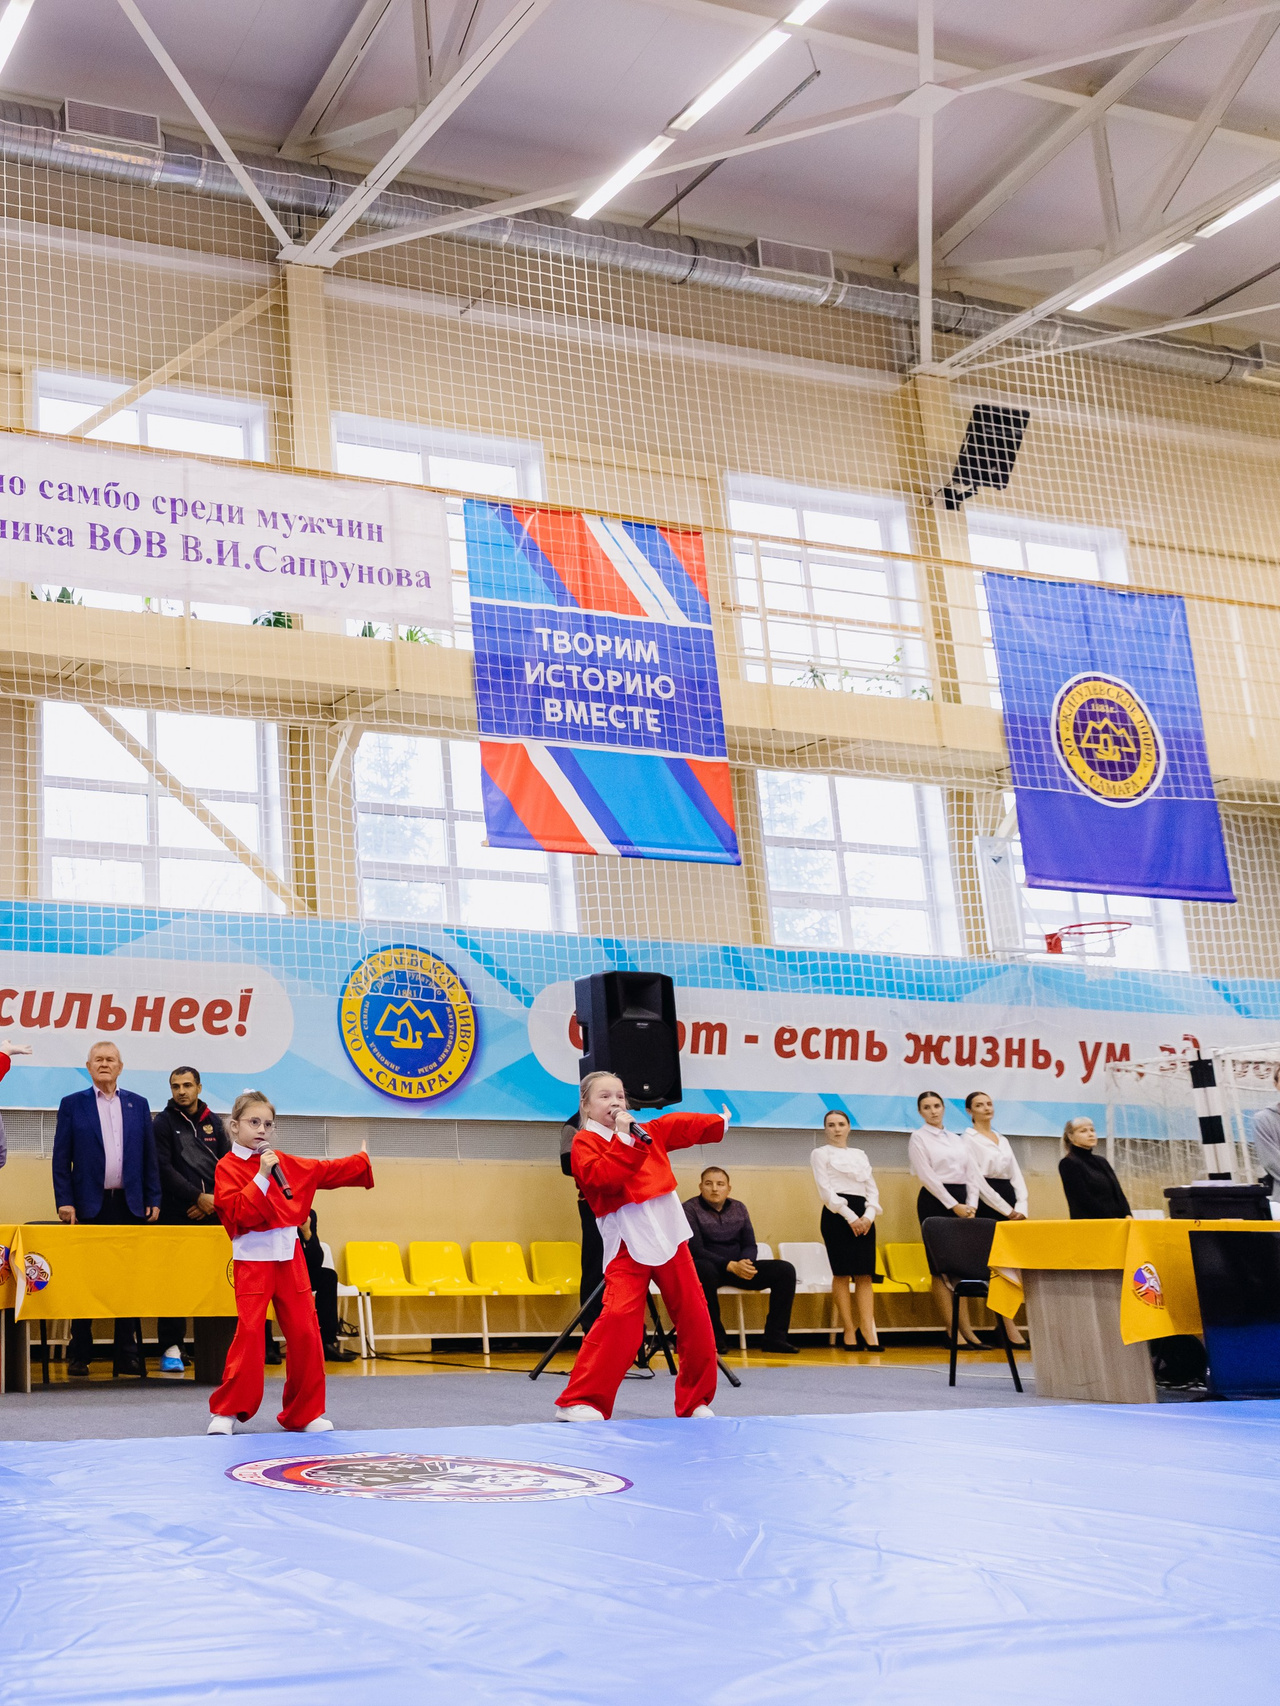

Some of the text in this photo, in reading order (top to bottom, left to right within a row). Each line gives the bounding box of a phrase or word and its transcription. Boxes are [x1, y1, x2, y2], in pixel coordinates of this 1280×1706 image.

[38, 479, 141, 511] самбо
[152, 494, 245, 525] среди
[257, 509, 385, 543] мужчин
[86, 522, 169, 559] ВОВ
[181, 533, 432, 588] В.И.Сапрунова
[535, 627, 660, 665] ТВОРИМ
[524, 661, 676, 700] ИСТОРИЮ
[543, 698, 662, 733] ВМЕСТЕ
[1089, 775, 1140, 796] САМАРА
[397, 989, 417, 997] 1881
[344, 1010, 363, 1052] ОАО
[774, 1026, 888, 1062] есть
[904, 1032, 1065, 1078] жизнь,
[375, 1070, 449, 1095] САМАРА
